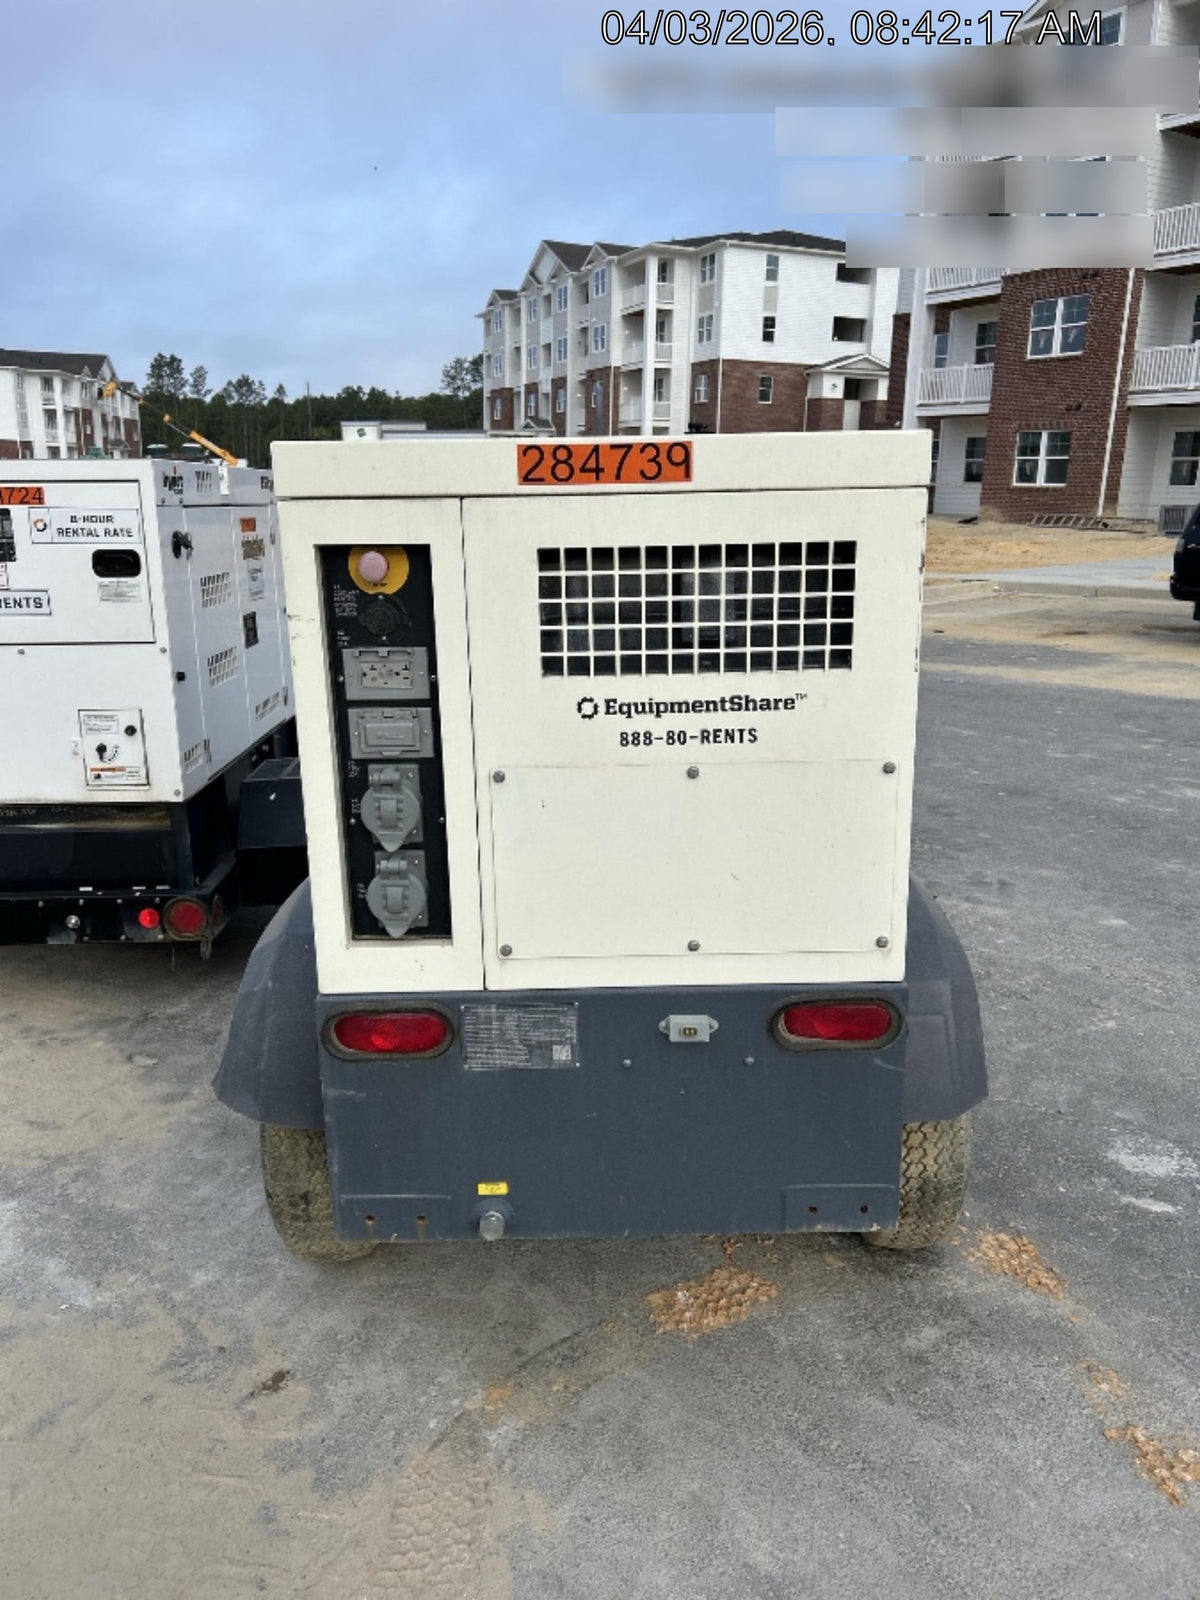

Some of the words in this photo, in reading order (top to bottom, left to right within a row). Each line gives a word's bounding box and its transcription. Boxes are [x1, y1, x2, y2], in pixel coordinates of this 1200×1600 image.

[521, 441, 692, 483] 284739
[56, 527, 100, 538] RENTAL
[104, 528, 134, 538] RATE
[0, 596, 44, 609] ENTS
[619, 728, 759, 747] 888-80-RENTS
